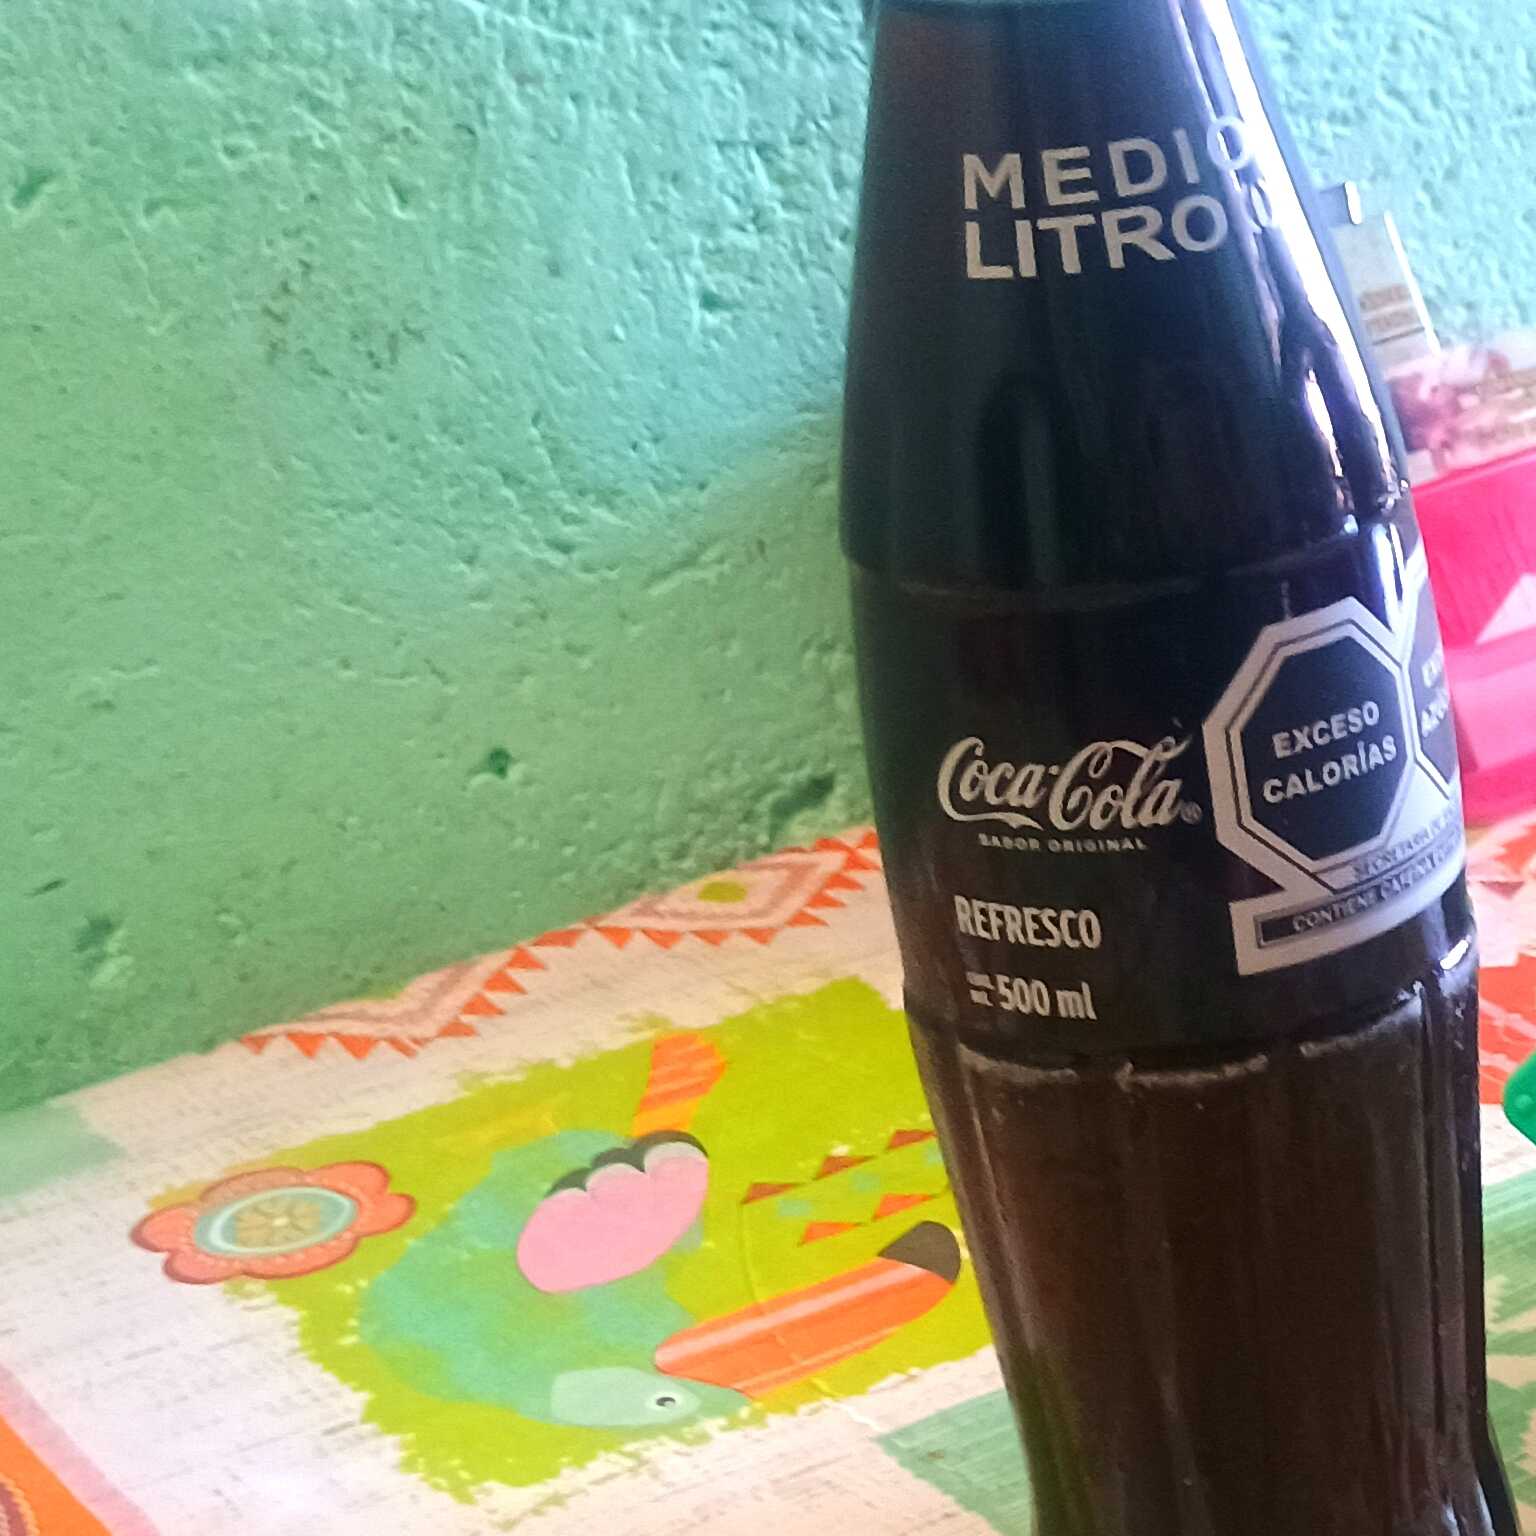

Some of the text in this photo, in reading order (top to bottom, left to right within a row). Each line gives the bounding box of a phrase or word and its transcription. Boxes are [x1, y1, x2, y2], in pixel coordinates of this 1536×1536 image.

[962, 115, 1251, 210] MEDIO
[965, 194, 1228, 279] LITRO
[1272, 701, 1380, 759] EXCESO
[937, 735, 1192, 831] Coca-Cola
[1263, 735, 1397, 803] CALORÍAS
[1048, 838, 1148, 852] ORIGINAL
[954, 895, 1102, 949] REFRESCO
[1056, 981, 1098, 1020] ml
